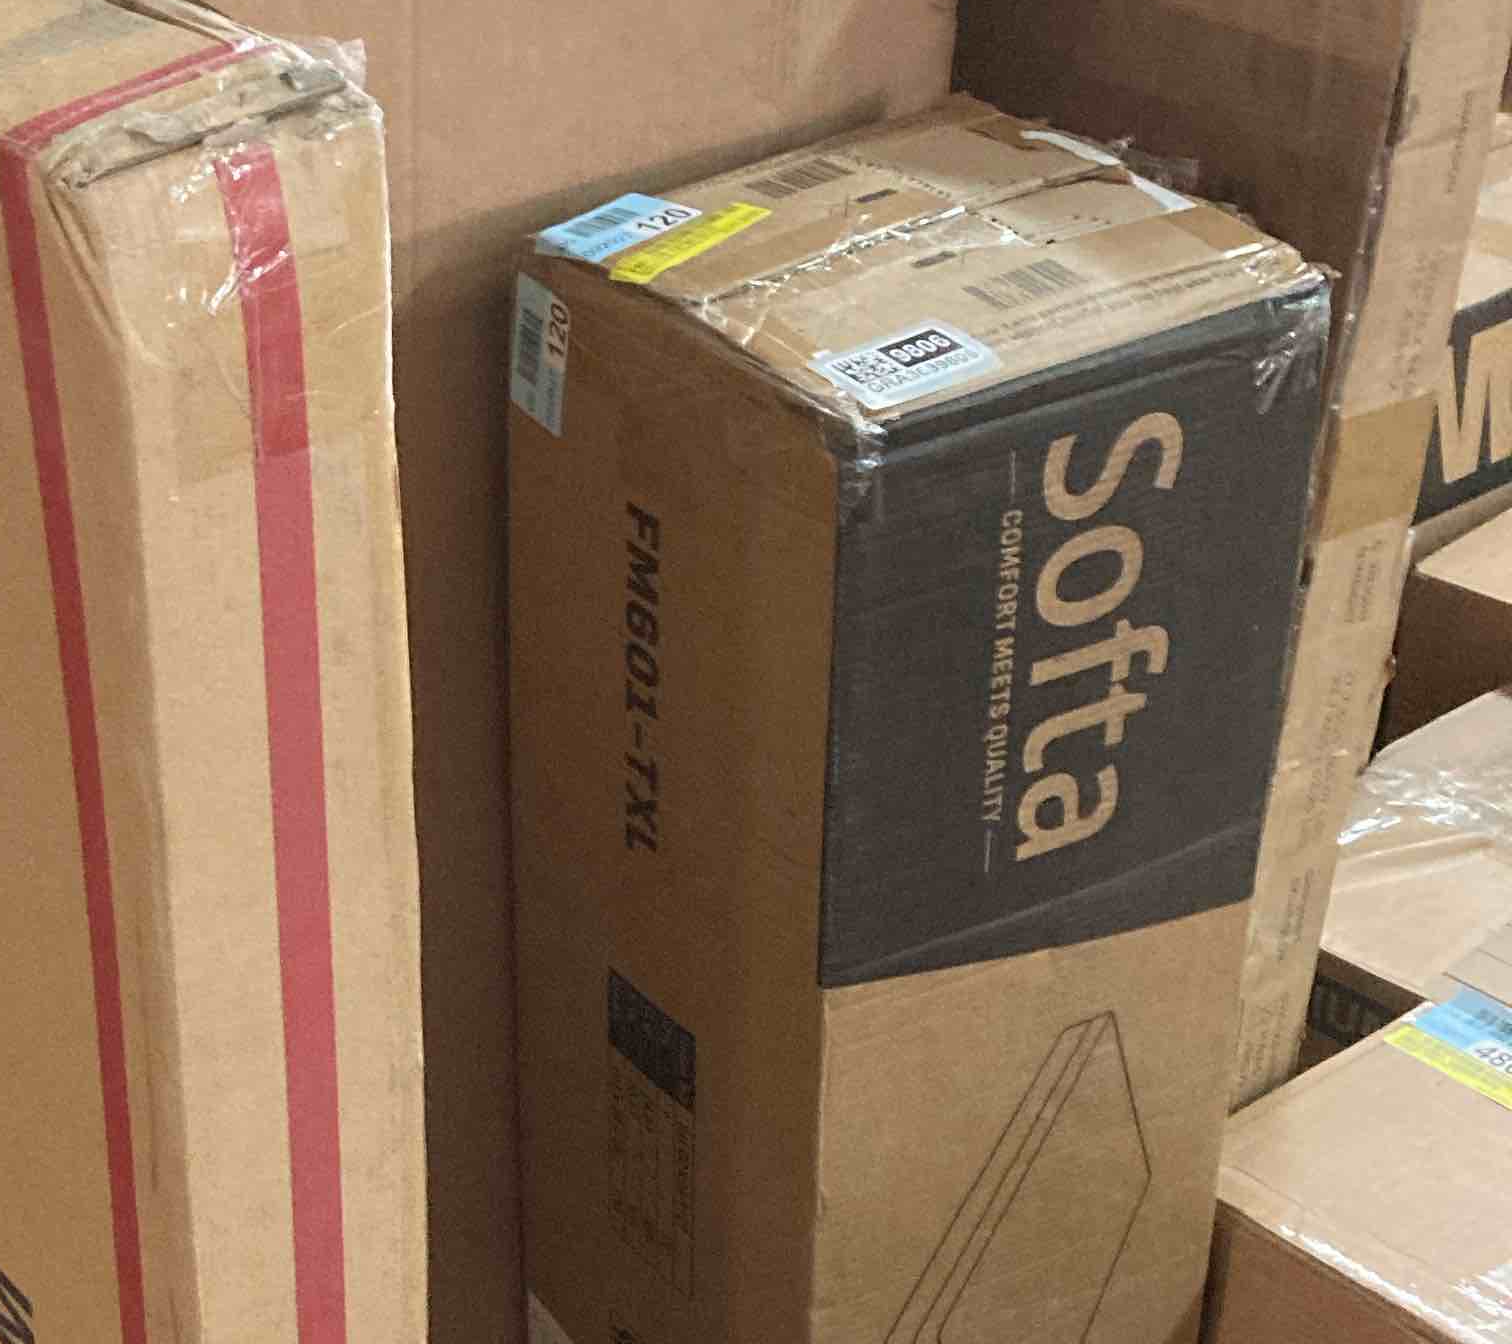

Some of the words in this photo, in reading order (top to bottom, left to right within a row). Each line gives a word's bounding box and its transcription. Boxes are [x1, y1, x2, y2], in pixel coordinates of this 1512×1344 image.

[637, 207, 691, 232] 120
[546, 302, 570, 359] 120
[889, 333, 953, 365] 9806
[994, 509, 1025, 643] COMFORT
[624, 499, 661, 854] FM601-TXL
[1016, 410, 1185, 863] Softa
[988, 644, 1014, 721] MEETS
[981, 722, 1011, 824] QUALITY
